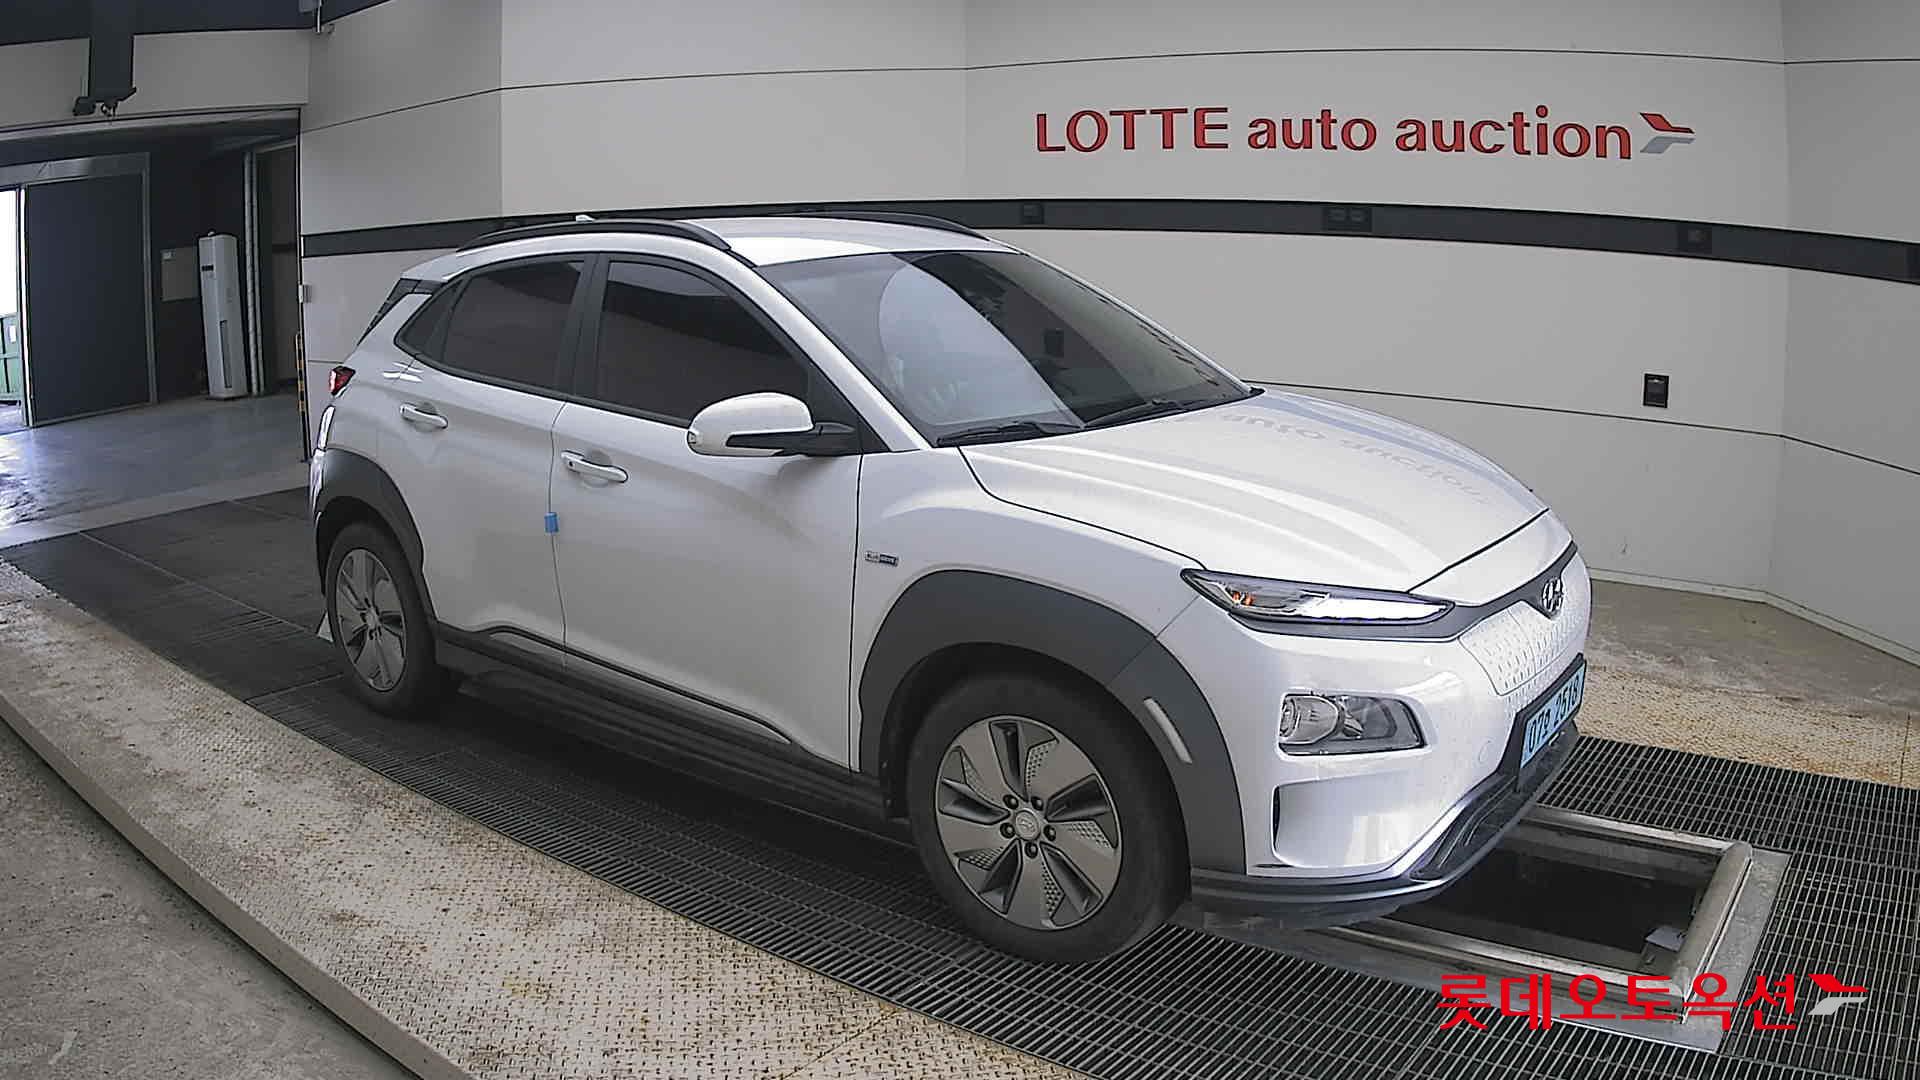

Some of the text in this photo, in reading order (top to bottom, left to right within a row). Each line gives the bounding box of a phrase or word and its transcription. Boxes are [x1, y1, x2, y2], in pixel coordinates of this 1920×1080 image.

[1035, 105, 1632, 159] LOTTE auto auction
